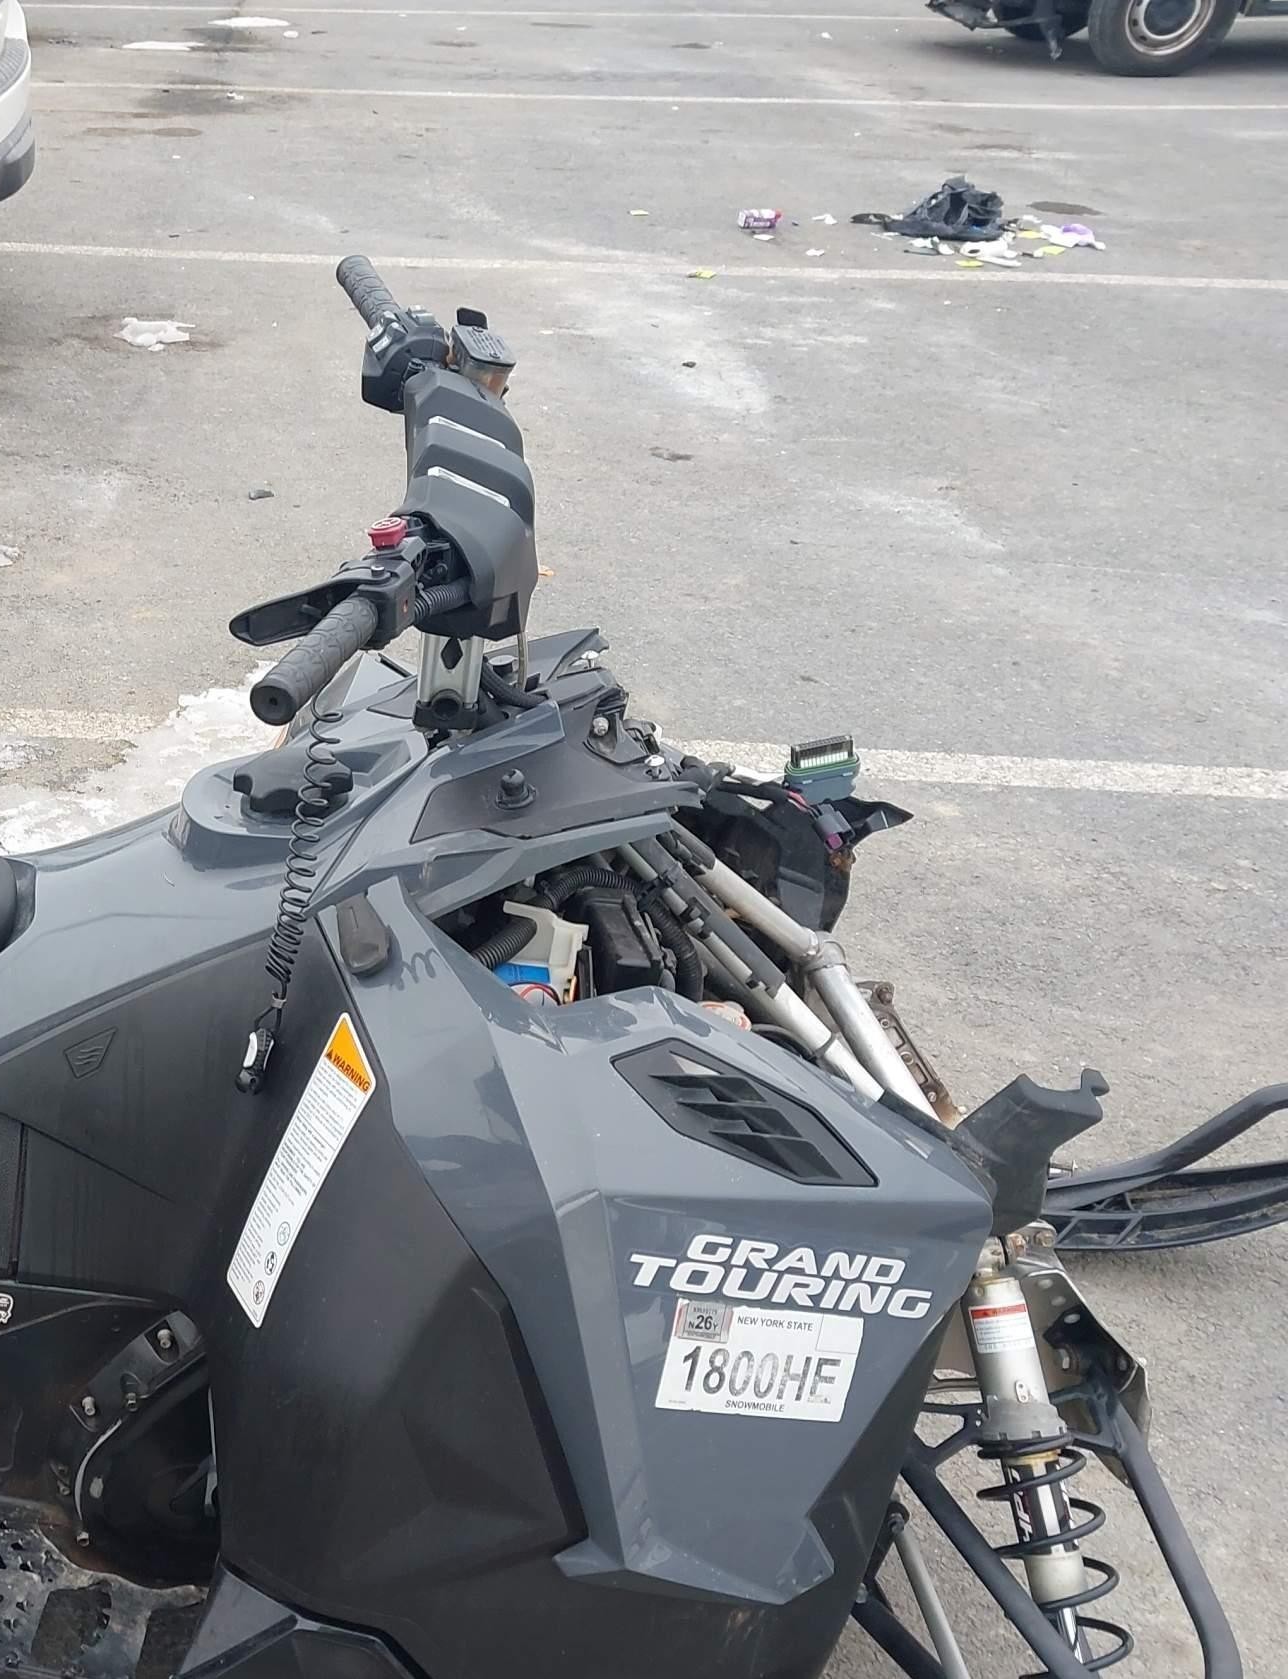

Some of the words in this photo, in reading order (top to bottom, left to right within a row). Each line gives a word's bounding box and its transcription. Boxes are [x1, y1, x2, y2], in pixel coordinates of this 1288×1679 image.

[333, 1053, 370, 1091] WARNING
[686, 1234, 906, 1284] GRAND
[630, 1254, 933, 1318] TOURING
[737, 1315, 757, 1326] NEW
[760, 1317, 785, 1329] YORK
[786, 1319, 814, 1331] STATE
[724, 1399, 785, 1413] SNOWMOBILE
